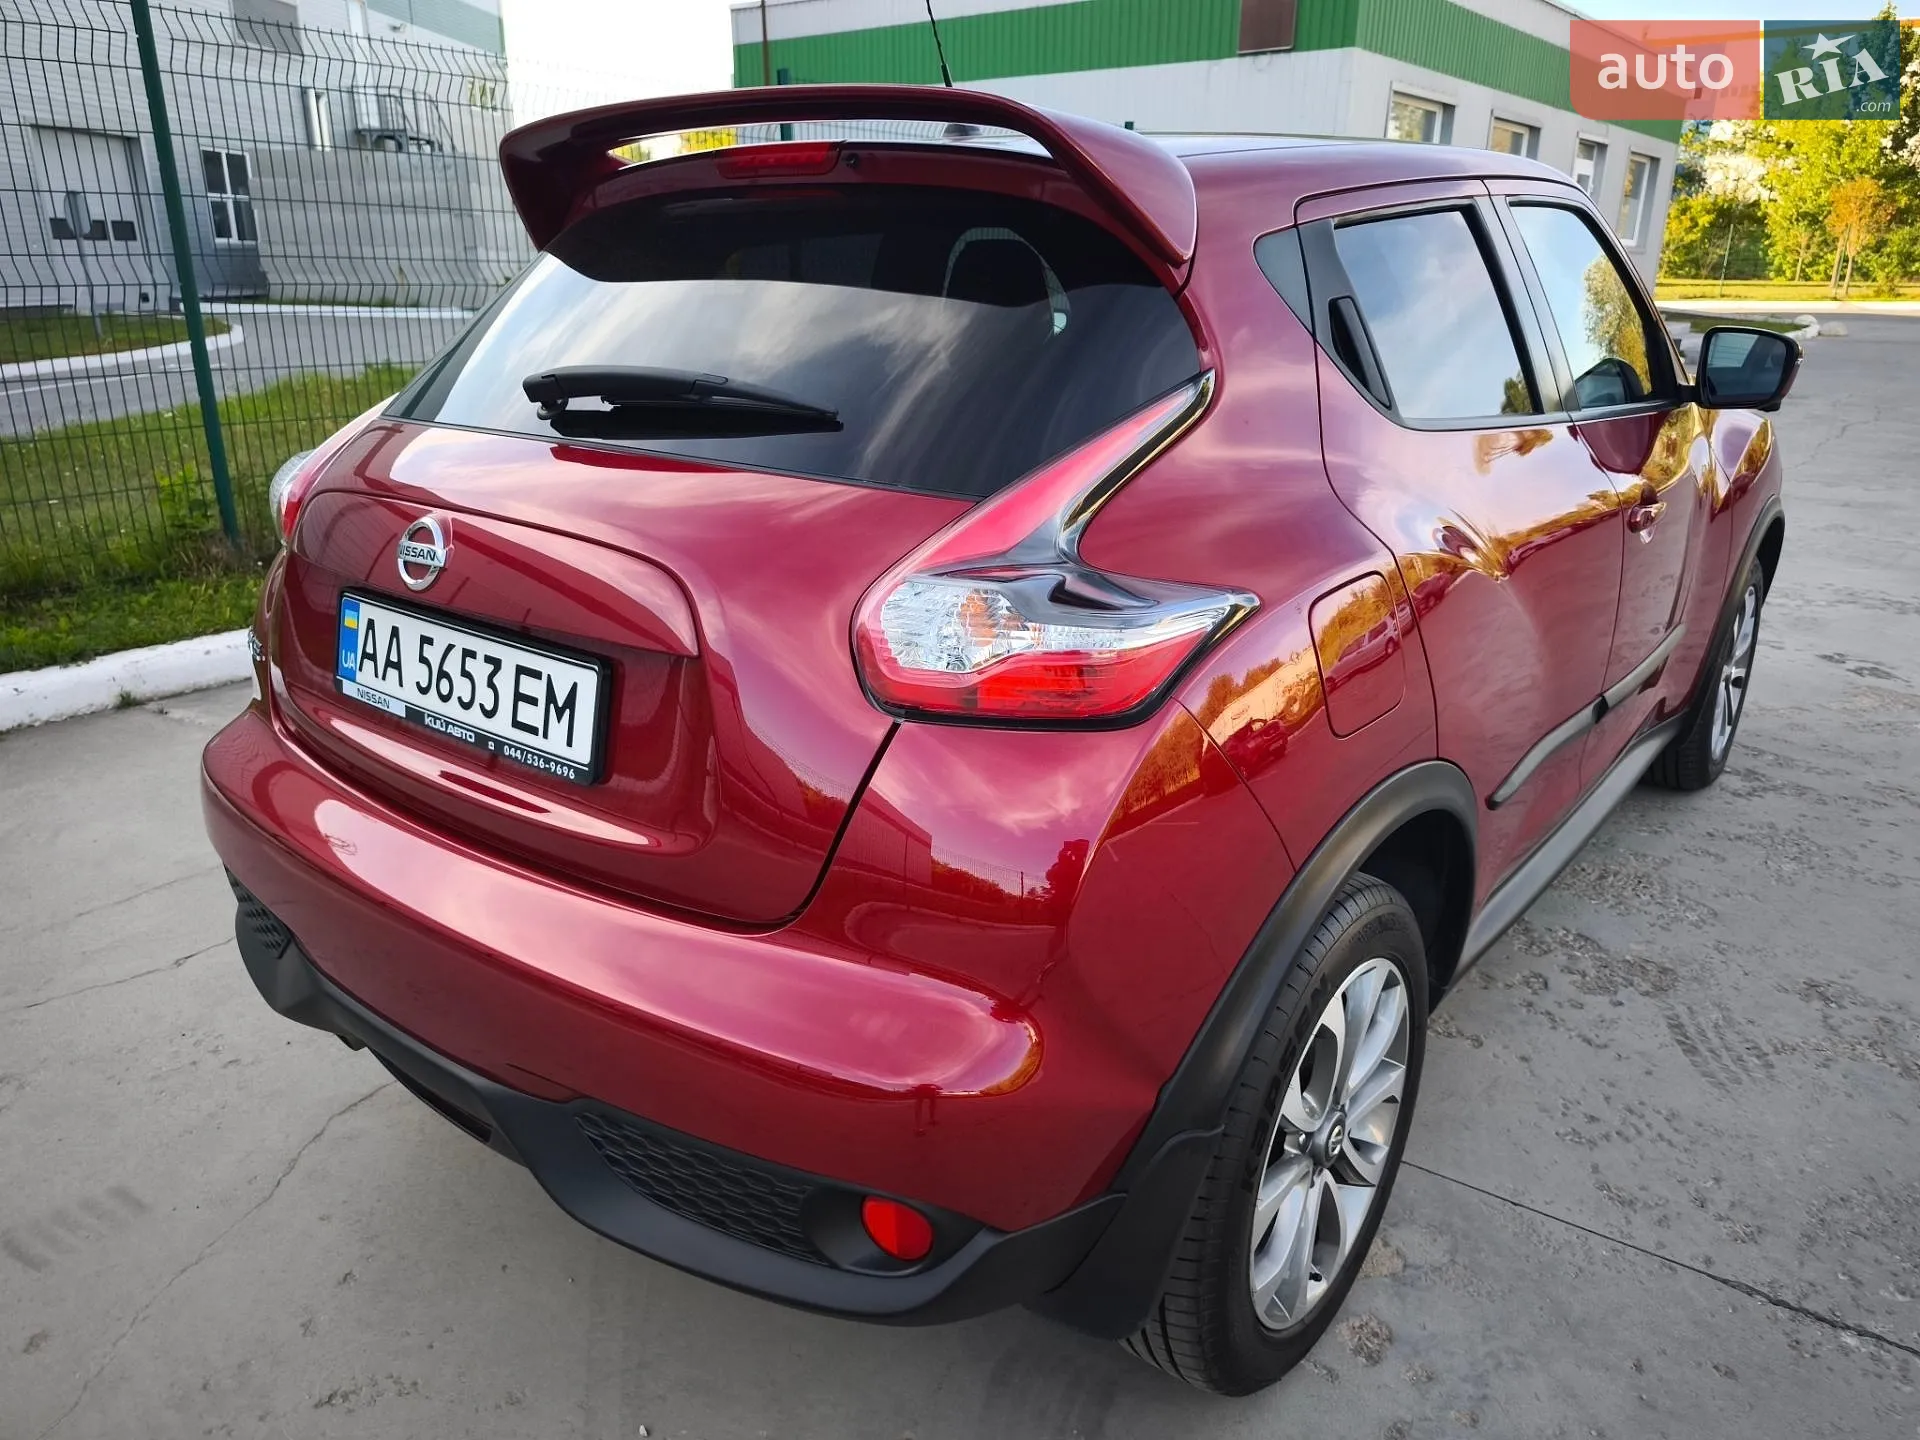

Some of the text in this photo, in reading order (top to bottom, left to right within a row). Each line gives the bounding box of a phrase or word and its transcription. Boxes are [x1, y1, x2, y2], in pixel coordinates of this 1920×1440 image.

[399, 544, 437, 562] NISSAN
[341, 649, 356, 671] UA
[358, 617, 404, 688] AA
[415, 633, 502, 719] 5653
[511, 663, 578, 748] EM
[356, 686, 391, 709] NISSAN
[503, 744, 576, 780] 044/536-9696
